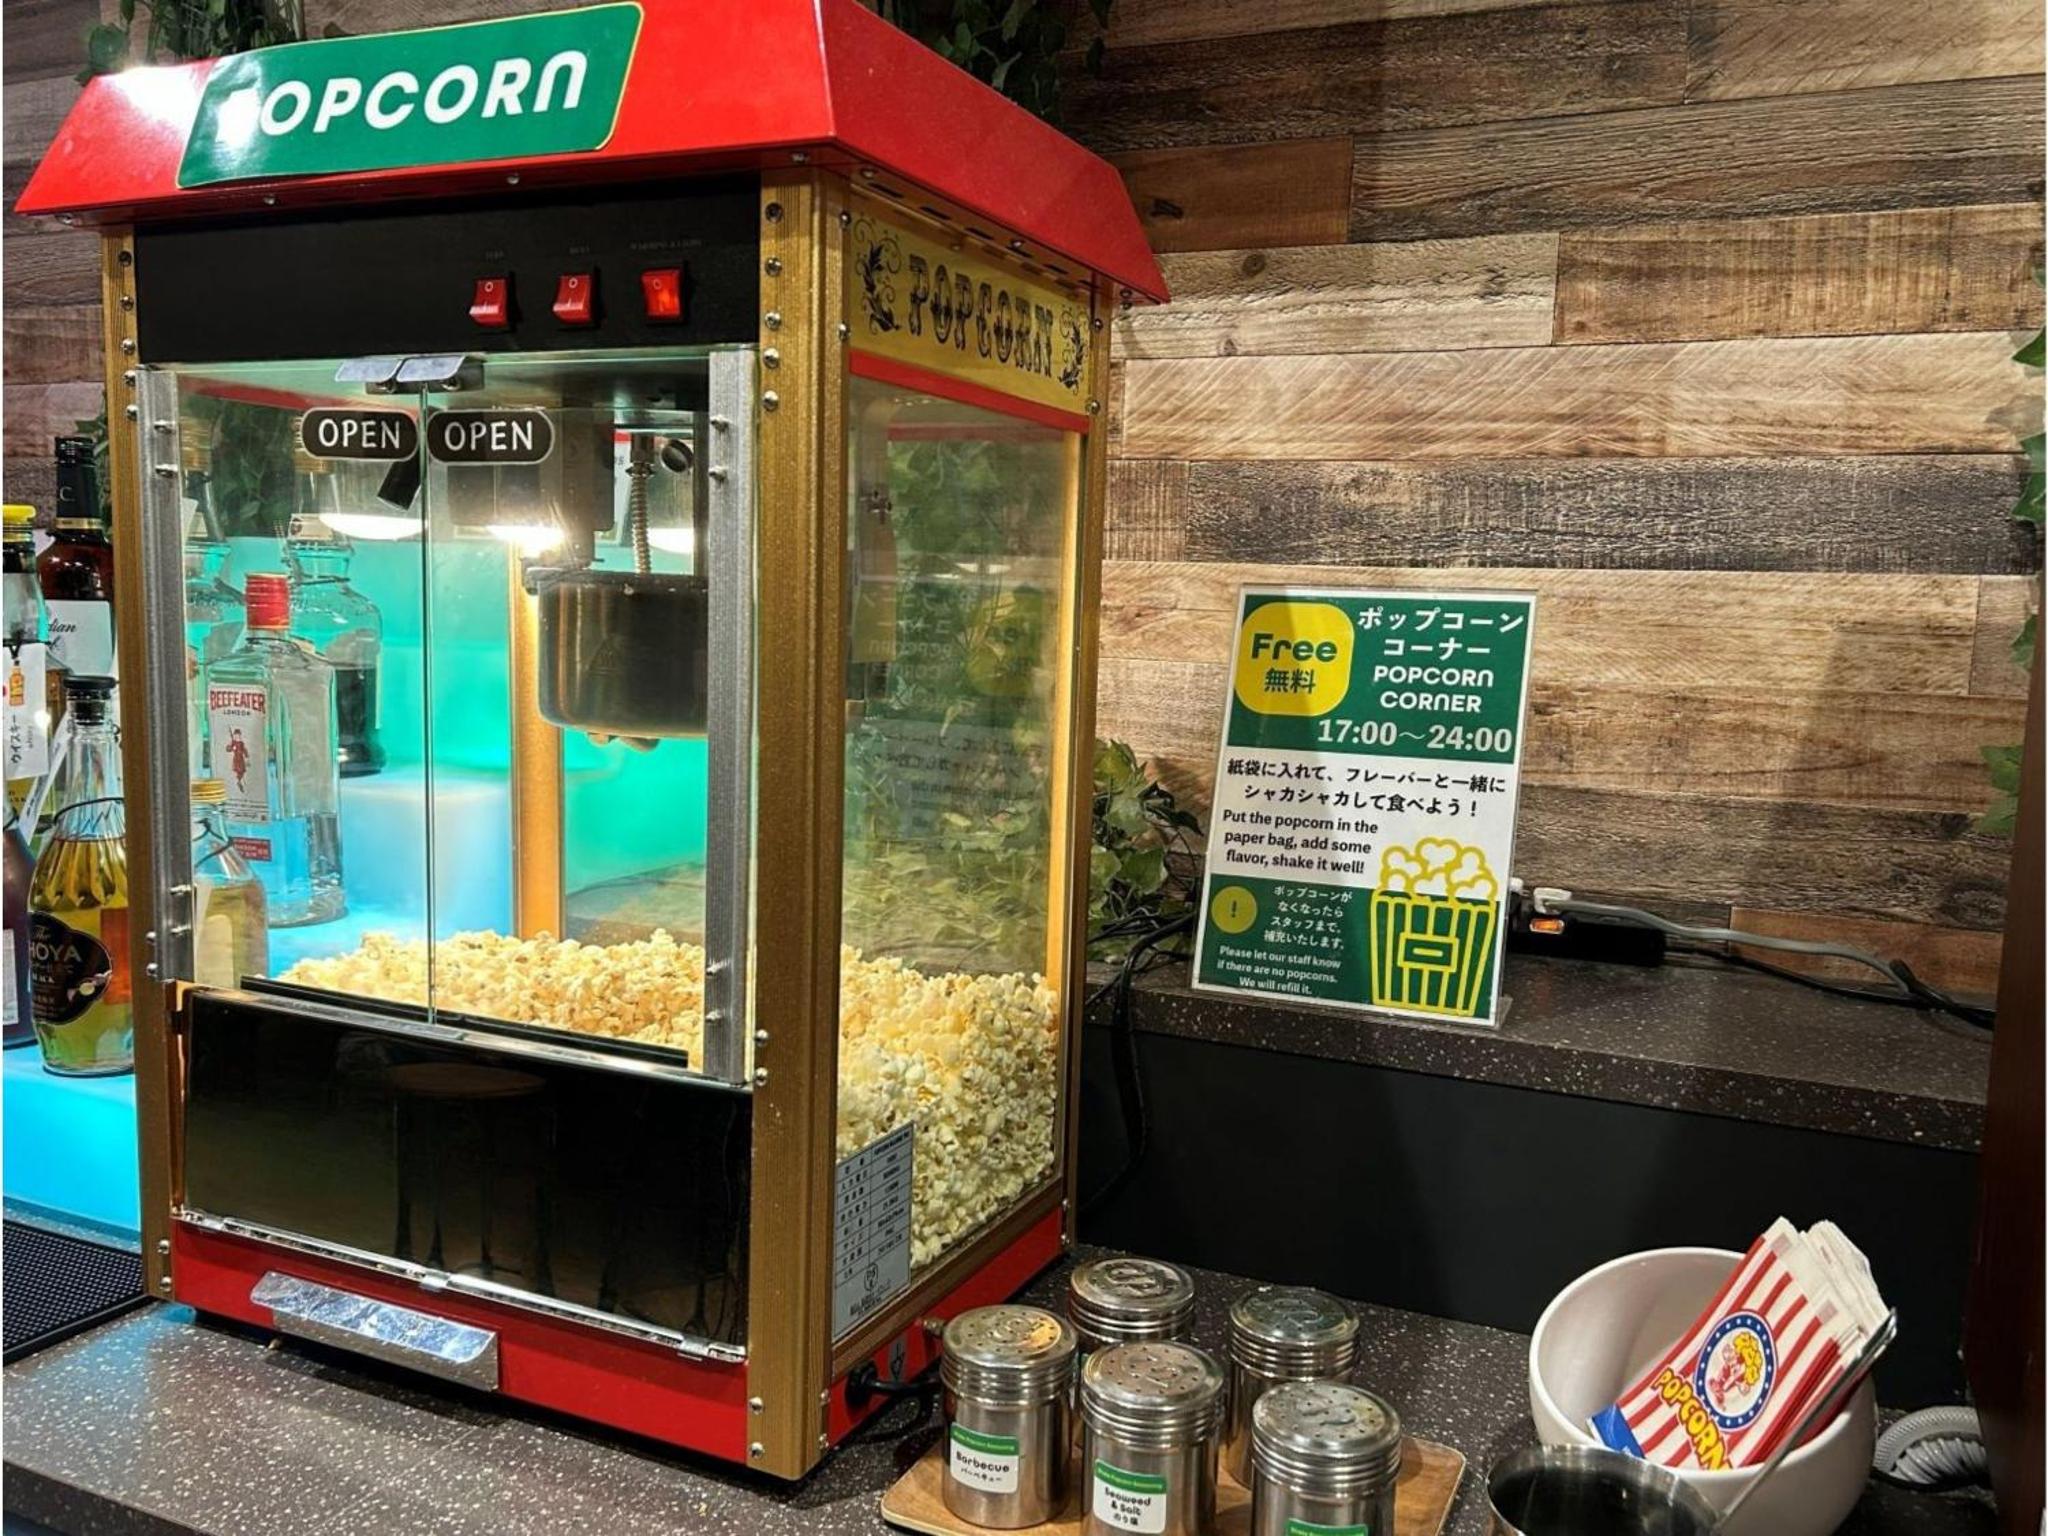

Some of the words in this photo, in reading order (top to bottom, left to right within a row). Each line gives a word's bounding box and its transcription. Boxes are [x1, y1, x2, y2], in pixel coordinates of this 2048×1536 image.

[908, 253, 1053, 378] POPCORN
[317, 418, 401, 449] OPEN
[444, 421, 533, 451] OPEN
[1357, 606, 1525, 633] ポップコーン
[1251, 633, 1338, 663] Free
[1383, 638, 1491, 661] コーナー
[1264, 667, 1316, 694] 無料
[1373, 665, 1494, 687] POPCORN
[210, 689, 266, 714] BEEFEATER
[1380, 691, 1482, 713] CORNER
[8, 714, 22, 764] ウイスキー
[1223, 809, 1246, 824] Put
[1249, 810, 1272, 825] the
[1274, 814, 1334, 830] popcorn
[1337, 817, 1351, 832] in
[1354, 819, 1379, 834] the
[1224, 831, 1265, 846] paper
[1267, 832, 1298, 850] bag,
[1300, 836, 1328, 850] add
[1331, 841, 1372, 854] some
[1226, 849, 1269, 867] flavor,
[1271, 853, 1314, 869] shake
[1316, 856, 1327, 871] it
[1330, 860, 1365, 874] well!
[1273, 885, 1353, 904] ポップコーンが
[1277, 900, 1344, 918] なくなったら
[28, 941, 82, 963] HOYA
[1219, 945, 1254, 959] Please
[1254, 949, 1267, 961] let
[1269, 952, 1285, 963] our
[1287, 953, 1311, 965] staff
[1312, 956, 1341, 969] know
[1217, 959, 1225, 969] if
[1225, 959, 1251, 973] there
[1253, 963, 1271, 975] are
[1271, 966, 1285, 976] no
[1286, 968, 1338, 983] popcorns.
[1239, 976, 1255, 987] We
[1257, 978, 1275, 990] will
[1277, 980, 1300, 993] refill
[1301, 984, 1312, 995] it.
[956, 1450, 1010, 1472] Barbecue
[1104, 1486, 1152, 1506] Seaweed
[1119, 1504, 1142, 1516] Salt
